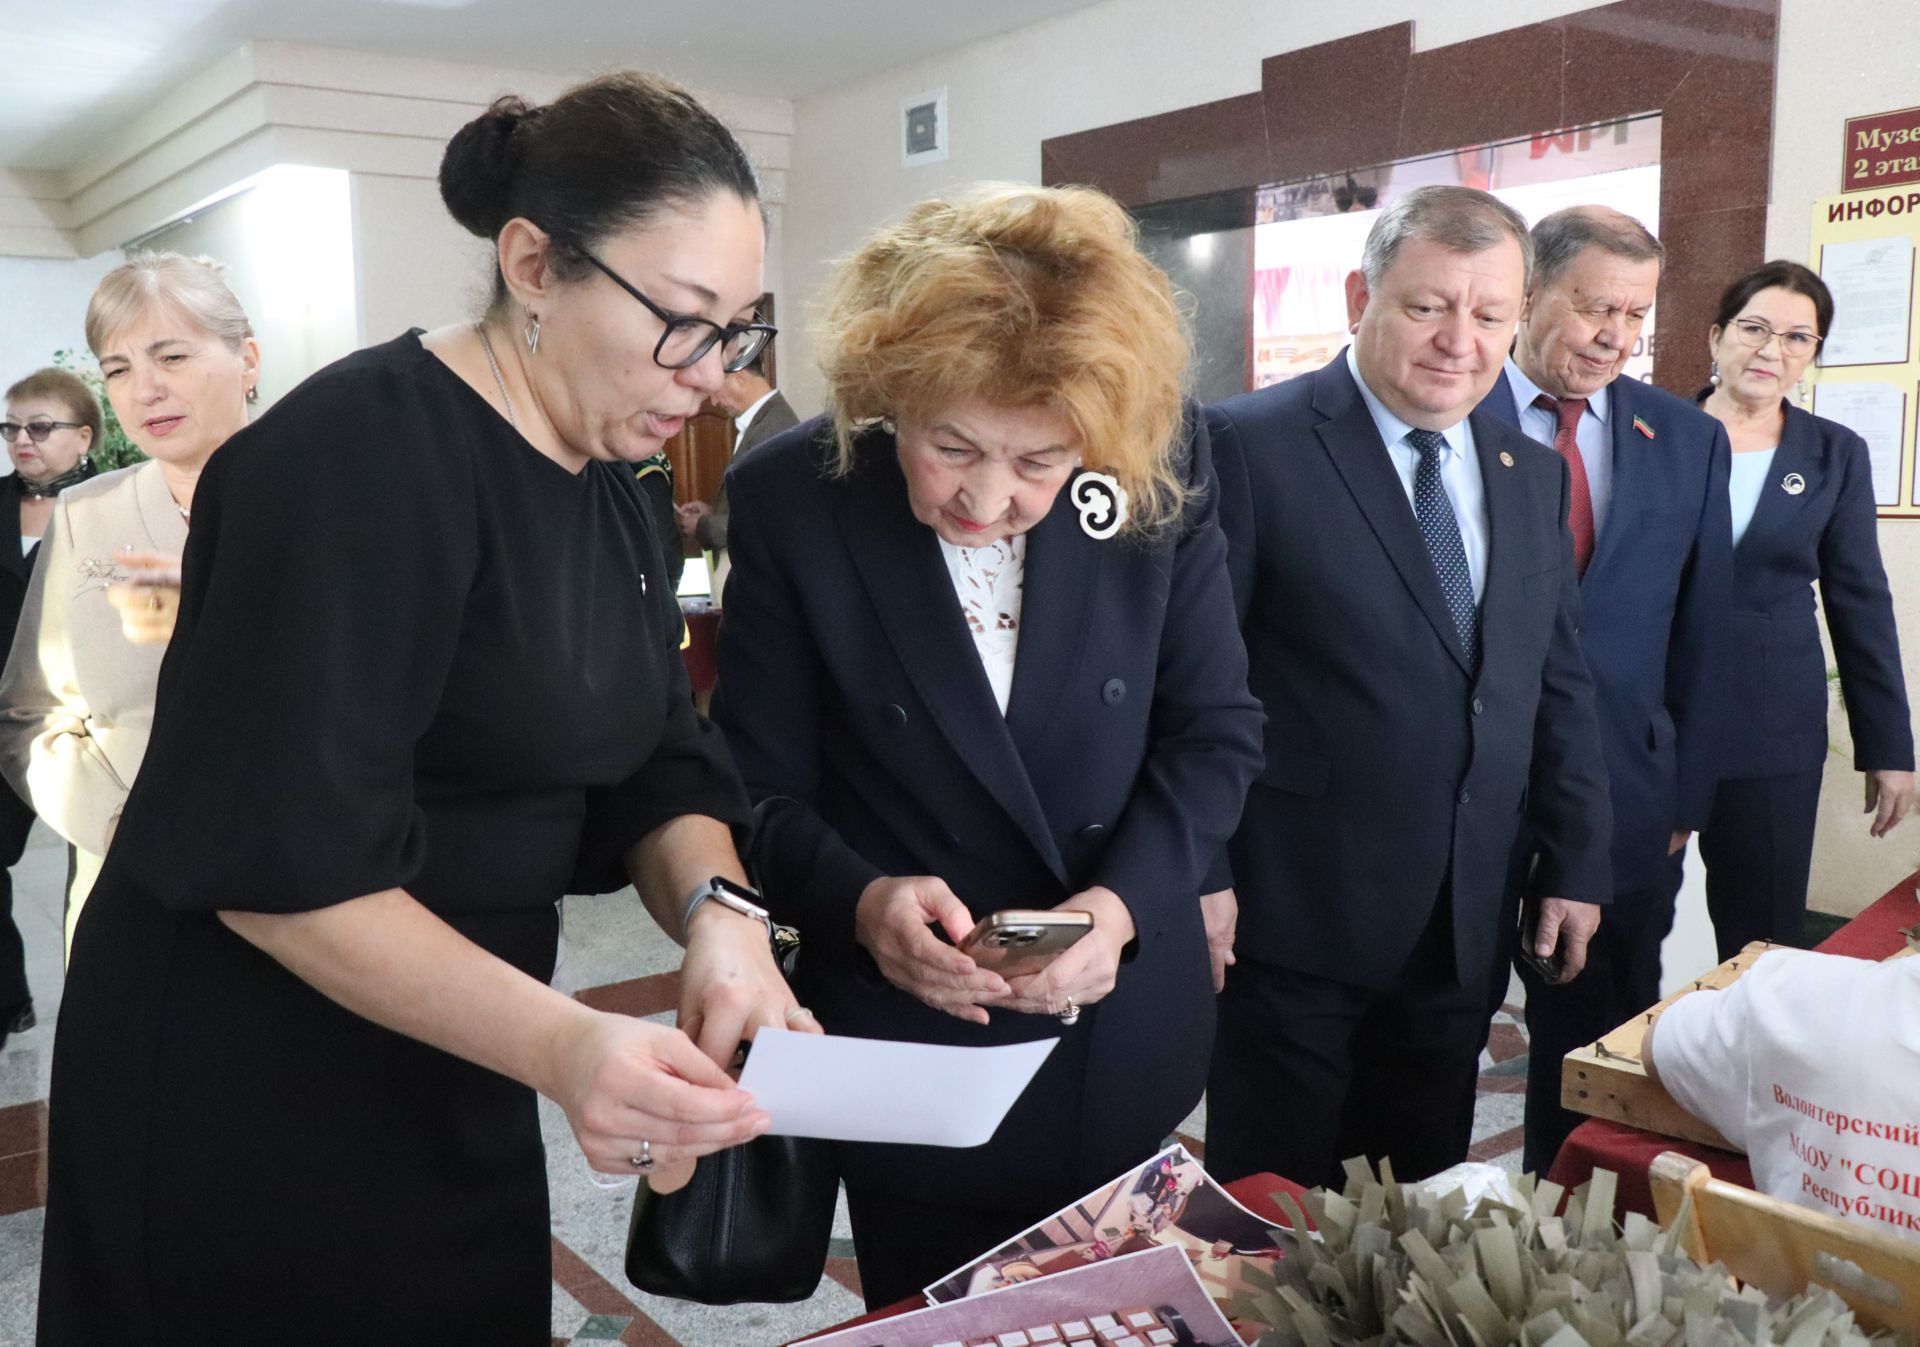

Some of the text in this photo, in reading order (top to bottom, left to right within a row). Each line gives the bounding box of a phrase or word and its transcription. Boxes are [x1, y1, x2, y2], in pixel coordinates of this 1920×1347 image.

[1855, 126, 1920, 152] Музе
[1853, 156, 1920, 179] 2 эта
[1828, 193, 1920, 223] ИНФОР
[1773, 1084, 1920, 1146] Волонтерский
[1789, 1131, 1832, 1172] МАОУ
[1802, 1171, 1920, 1232] Республик
